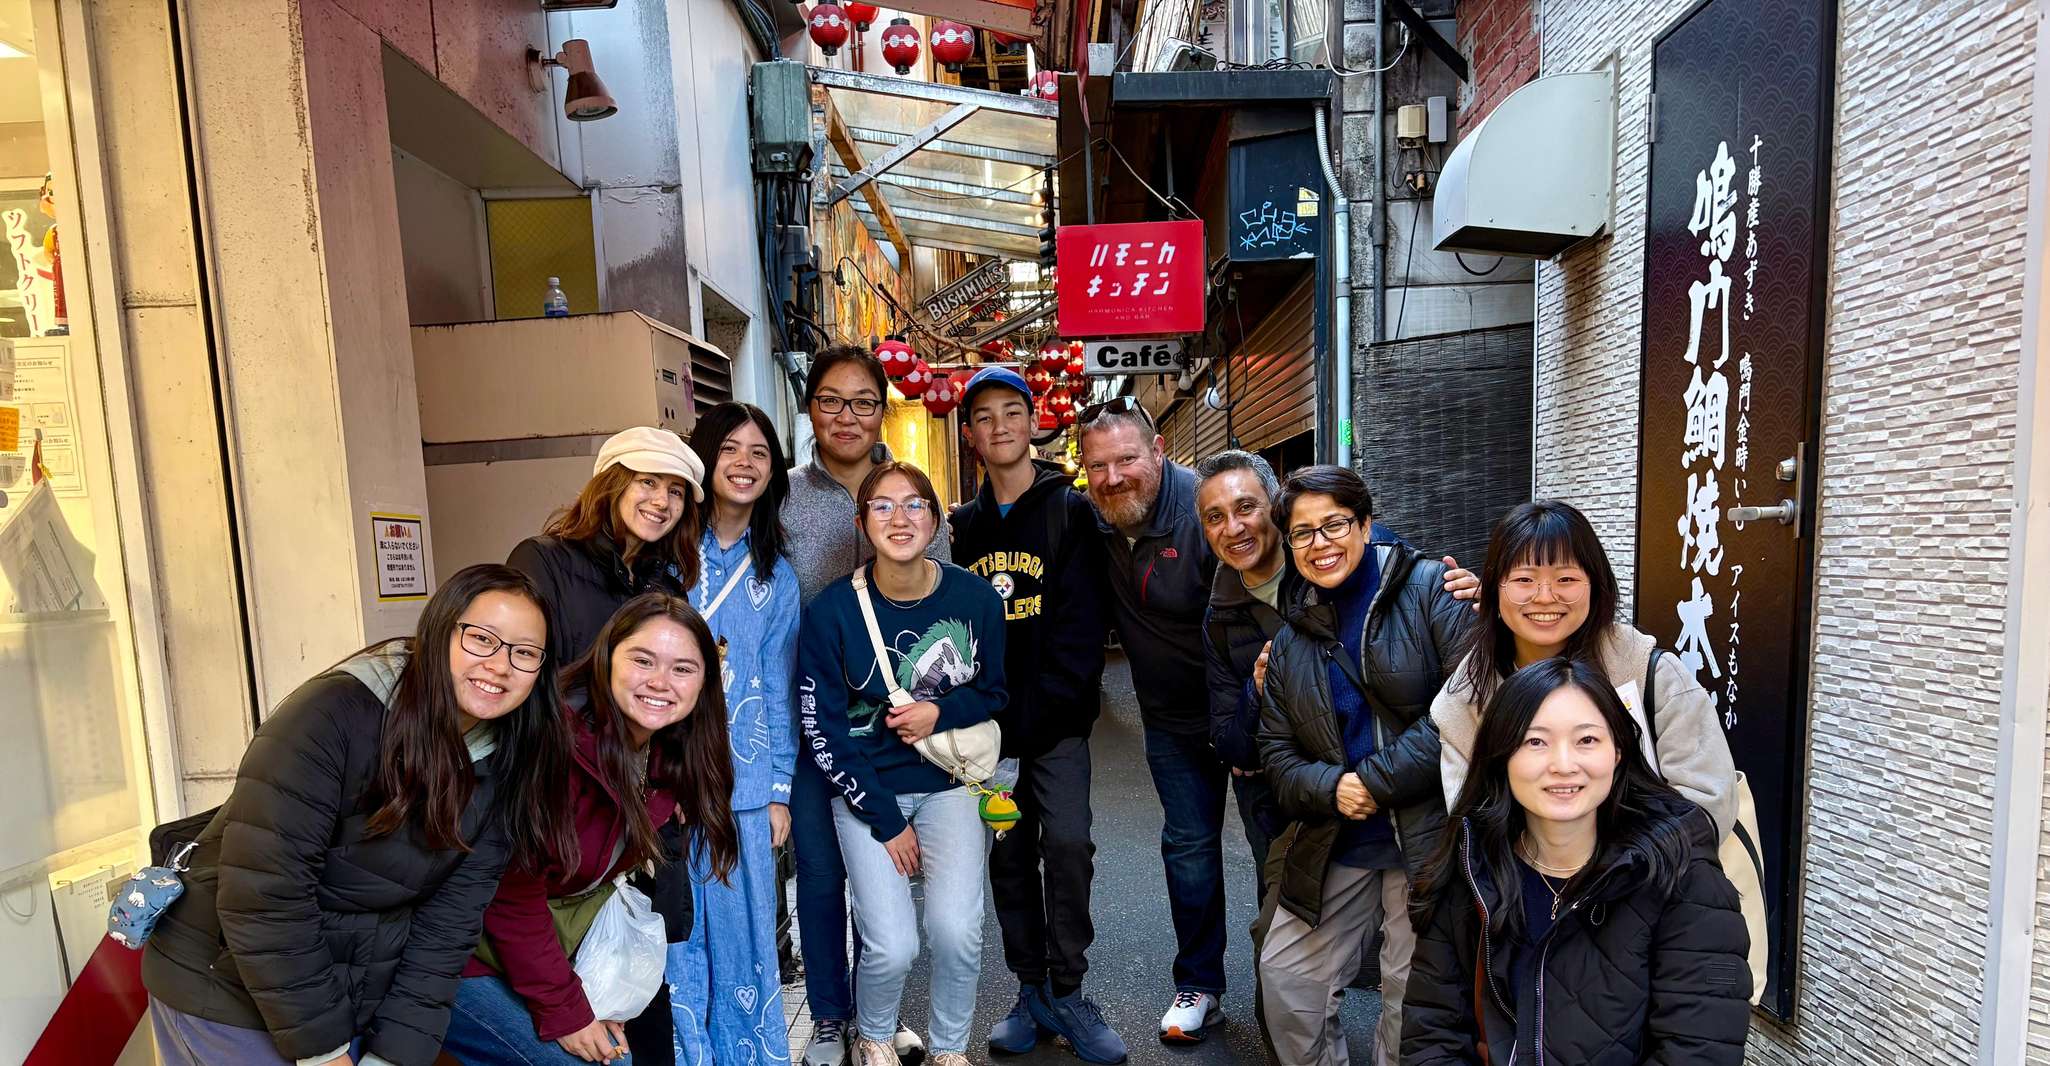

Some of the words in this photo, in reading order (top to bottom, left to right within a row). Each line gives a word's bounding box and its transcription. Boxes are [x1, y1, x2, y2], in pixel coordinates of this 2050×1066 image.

[1089, 241, 1176, 268] ハモニカ
[1743, 134, 1763, 321] 十勝産あずき
[8, 212, 39, 336] ソフトクリー
[927, 265, 1005, 322] BUSHMILLS
[1086, 271, 1170, 298] キッチン
[1096, 344, 1172, 369] Café
[1675, 141, 1738, 707] 鳴門鯛焼本
[966, 551, 1044, 584] TTSBURG
[1003, 594, 1042, 620] LERS
[1725, 564, 1744, 730] アイスもなか
[800, 675, 866, 811] 千と千尋の神隠し
